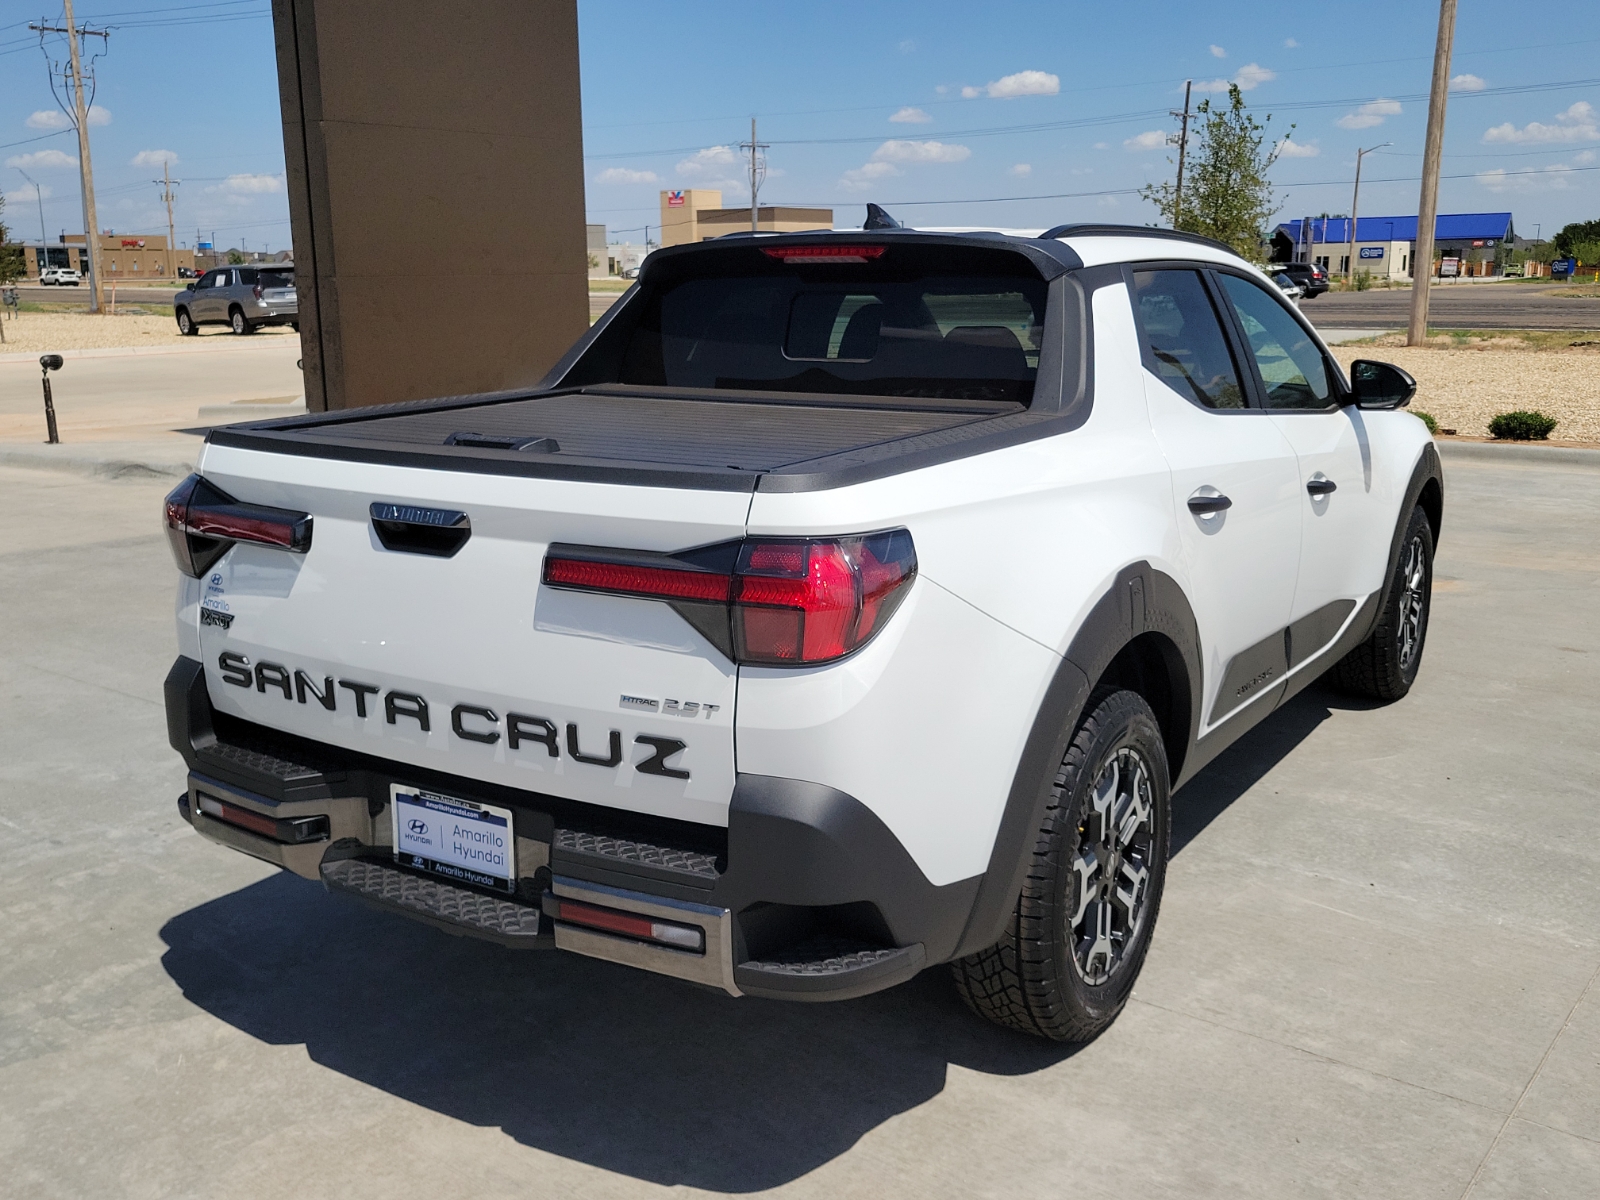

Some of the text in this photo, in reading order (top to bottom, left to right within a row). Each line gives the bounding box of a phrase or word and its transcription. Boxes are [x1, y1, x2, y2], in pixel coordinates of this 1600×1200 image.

[382, 505, 444, 524] HYUNDAI
[203, 595, 230, 611] Amarillo
[201, 607, 235, 630] XRT
[218, 651, 691, 780] SANTA CRUZ
[622, 695, 720, 720] HTRAC 2.5T
[425, 801, 479, 819] AmarilloHyundai.com
[405, 833, 433, 846] HYUNDAI
[452, 825, 504, 848] Amarillo
[453, 841, 505, 866] Hyundai
[435, 863, 495, 886] Amarillo Hyundai
